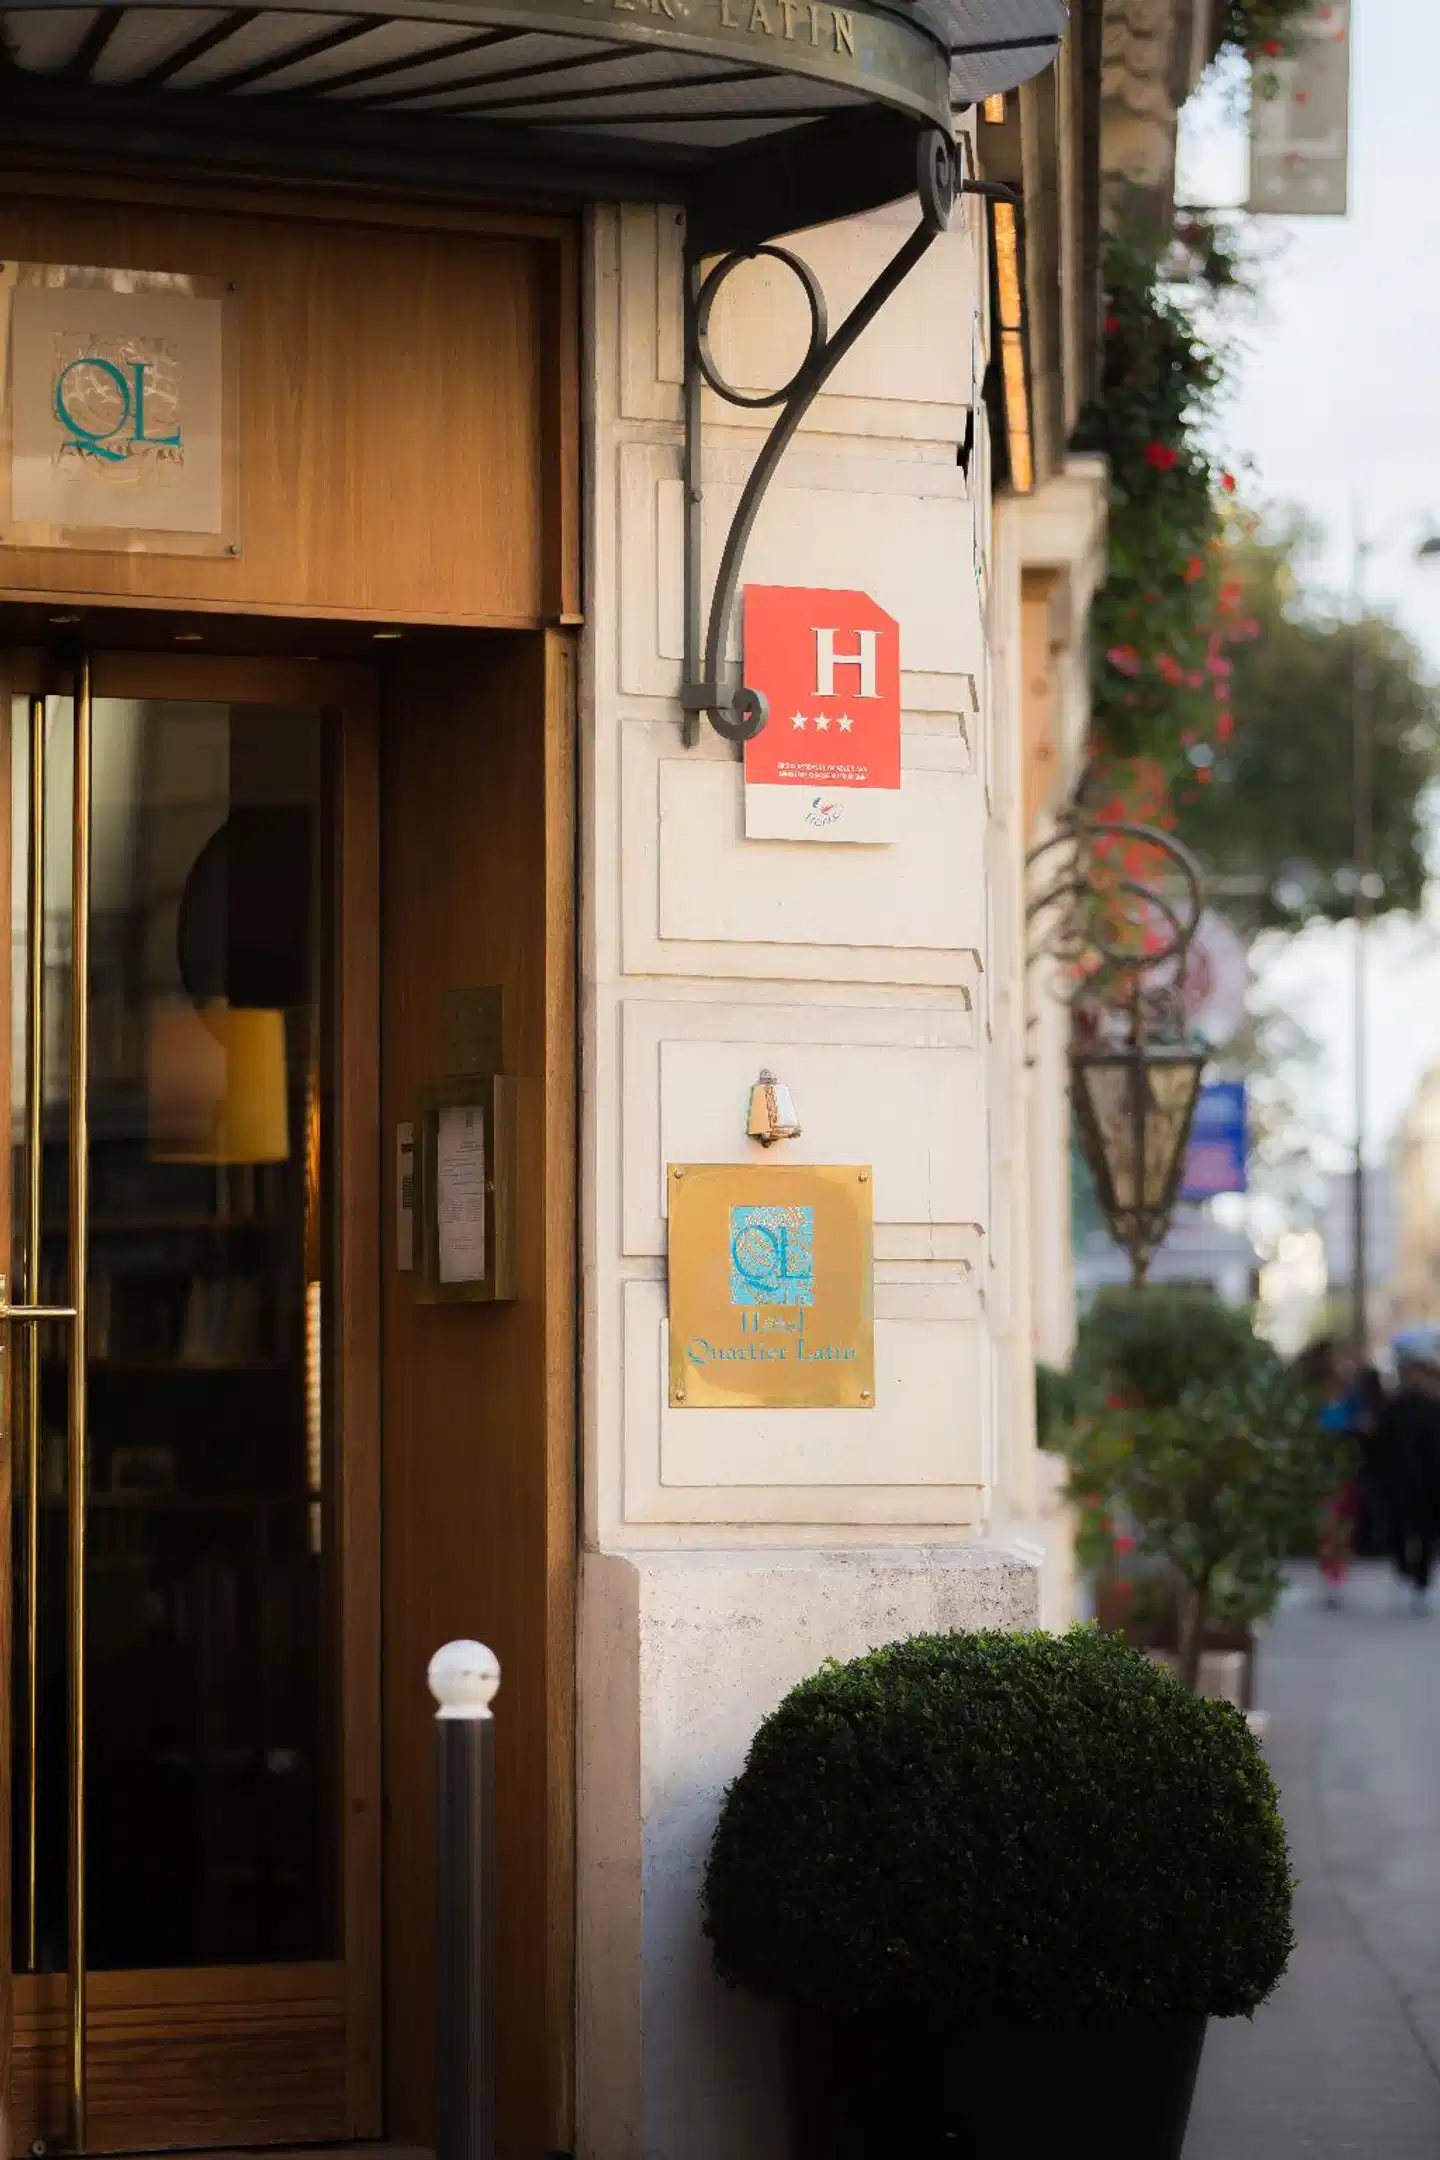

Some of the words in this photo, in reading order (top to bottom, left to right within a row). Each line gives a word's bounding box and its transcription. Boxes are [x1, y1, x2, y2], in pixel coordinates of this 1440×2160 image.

[720, 0, 855, 57] LATIN
[56, 357, 182, 462] QL
[810, 627, 885, 699] H
[732, 1223, 813, 1292] QL
